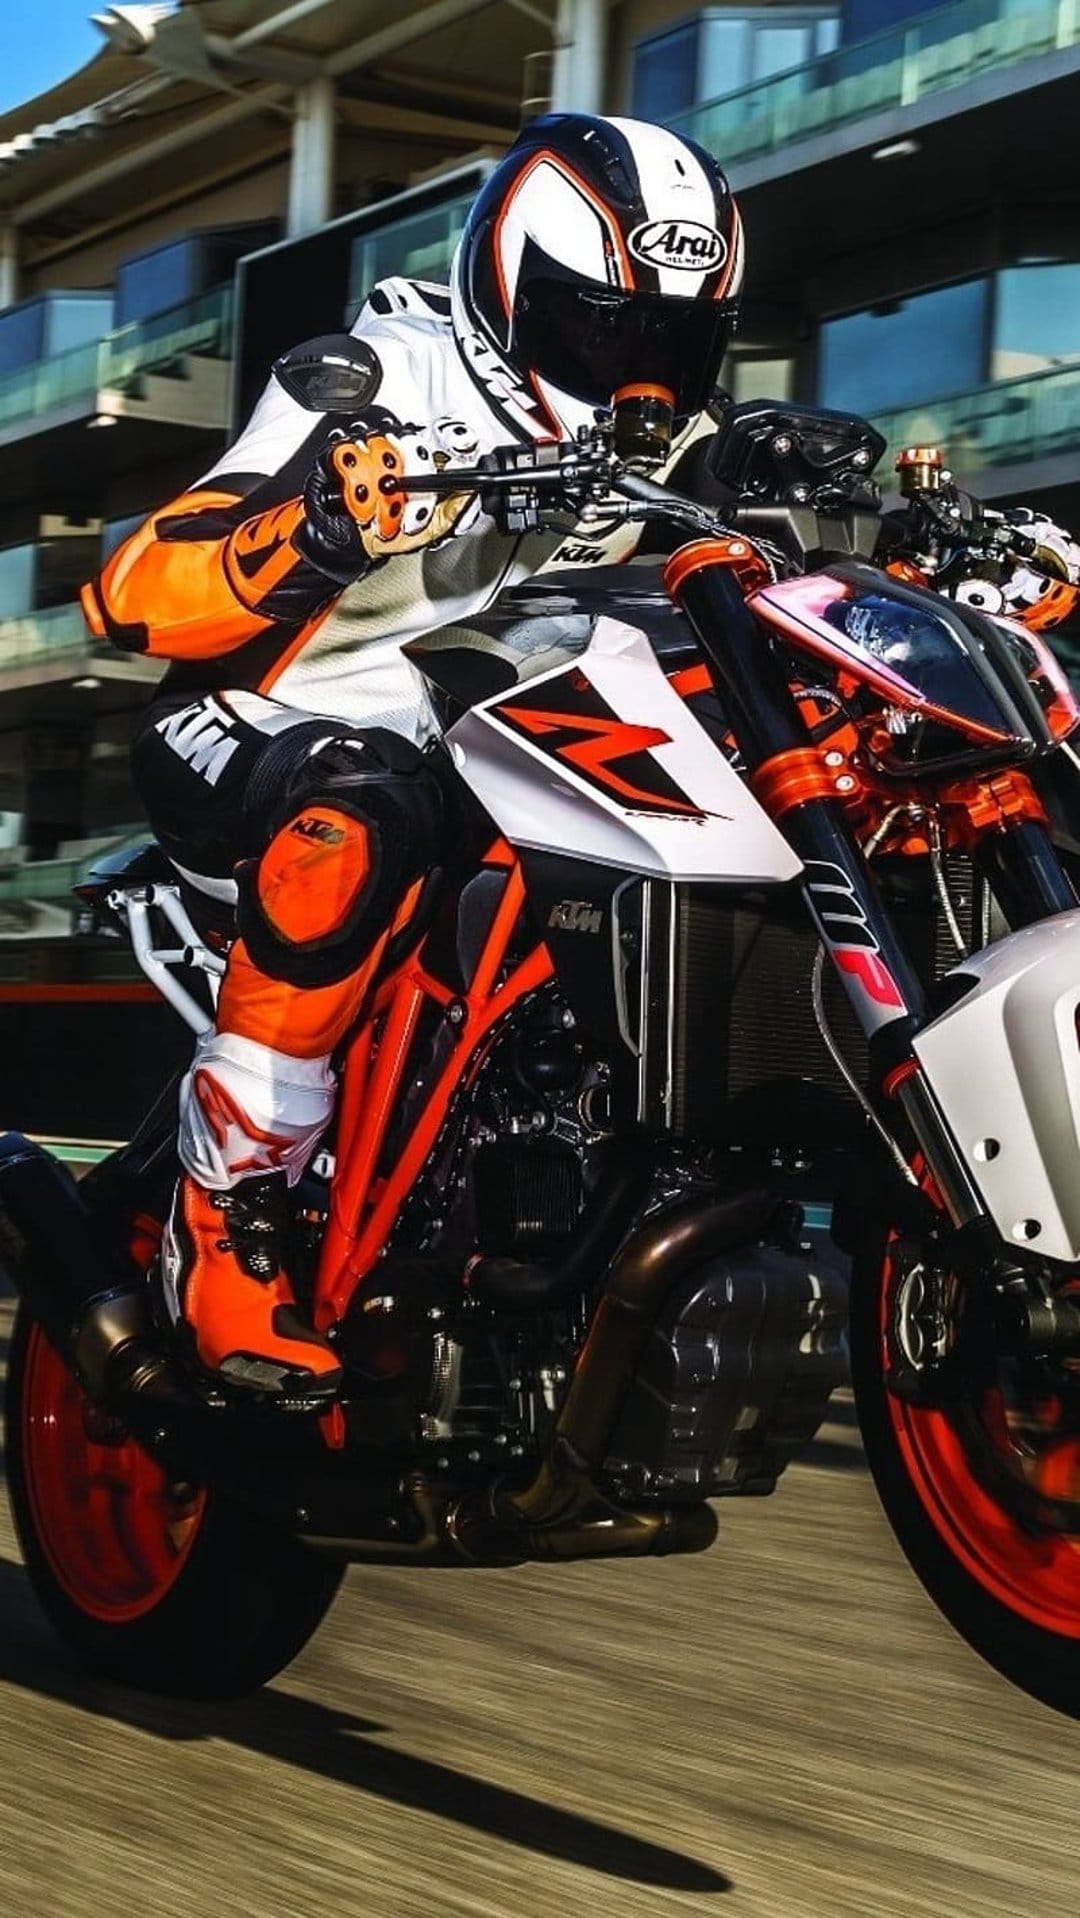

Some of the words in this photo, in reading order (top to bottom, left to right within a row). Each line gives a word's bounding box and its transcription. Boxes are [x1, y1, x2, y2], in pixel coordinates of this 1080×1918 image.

[639, 224, 717, 259] Arai
[551, 543, 608, 563] KTM
[154, 694, 240, 787] KTM
[547, 900, 602, 933] KTM
